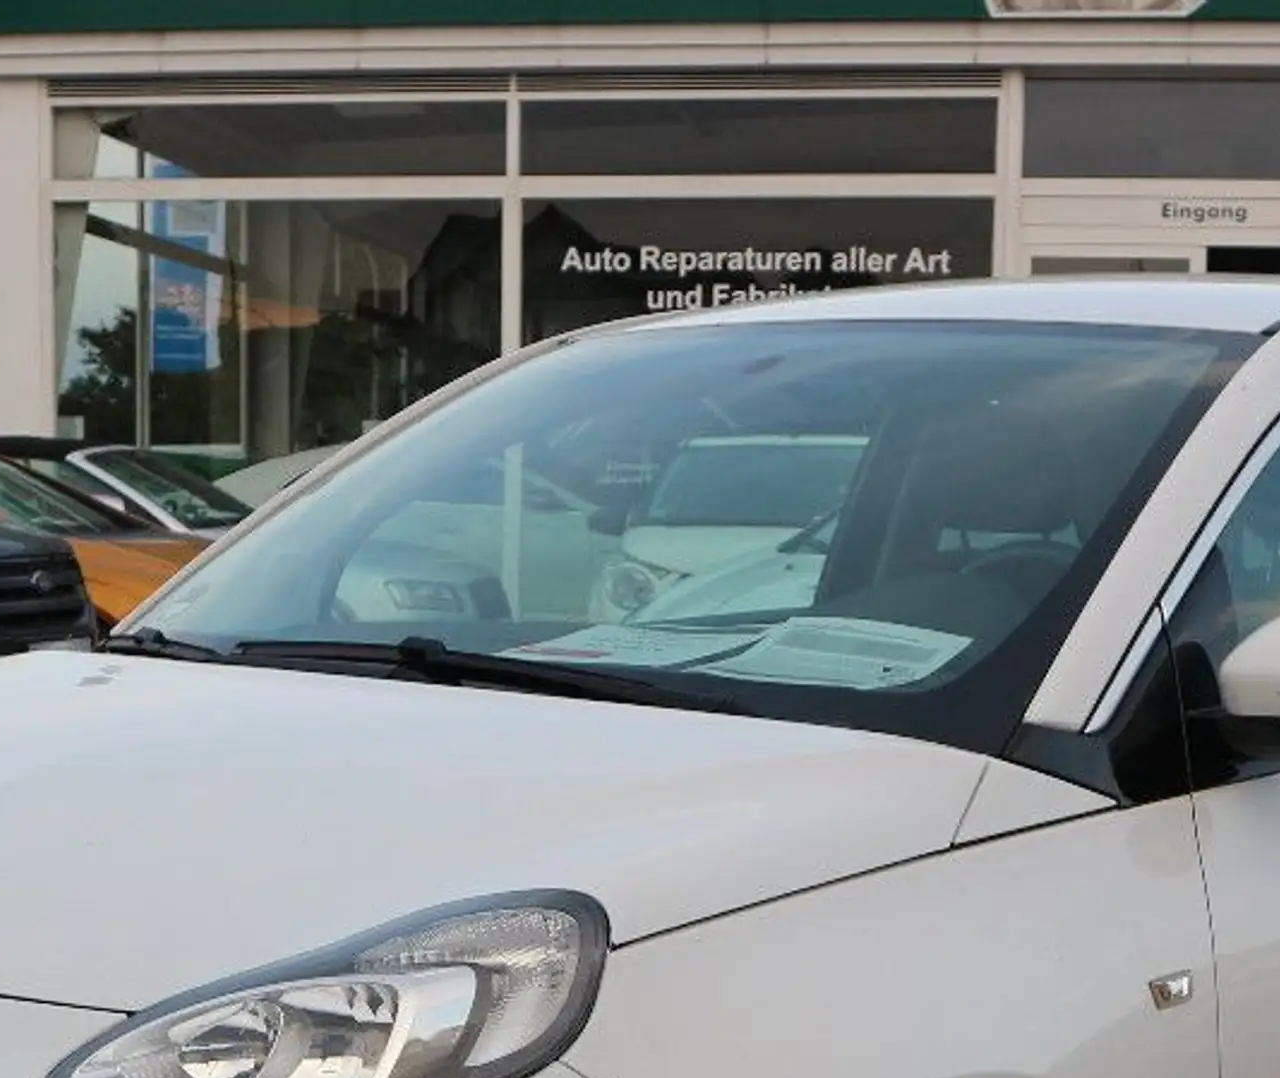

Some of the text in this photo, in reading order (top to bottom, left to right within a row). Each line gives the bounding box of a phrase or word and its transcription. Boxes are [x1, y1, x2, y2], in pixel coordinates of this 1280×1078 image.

[1161, 202, 1248, 223] Eingang
[561, 245, 952, 277] Auto Reparaturen aller Art
[646, 284, 703, 310] und
